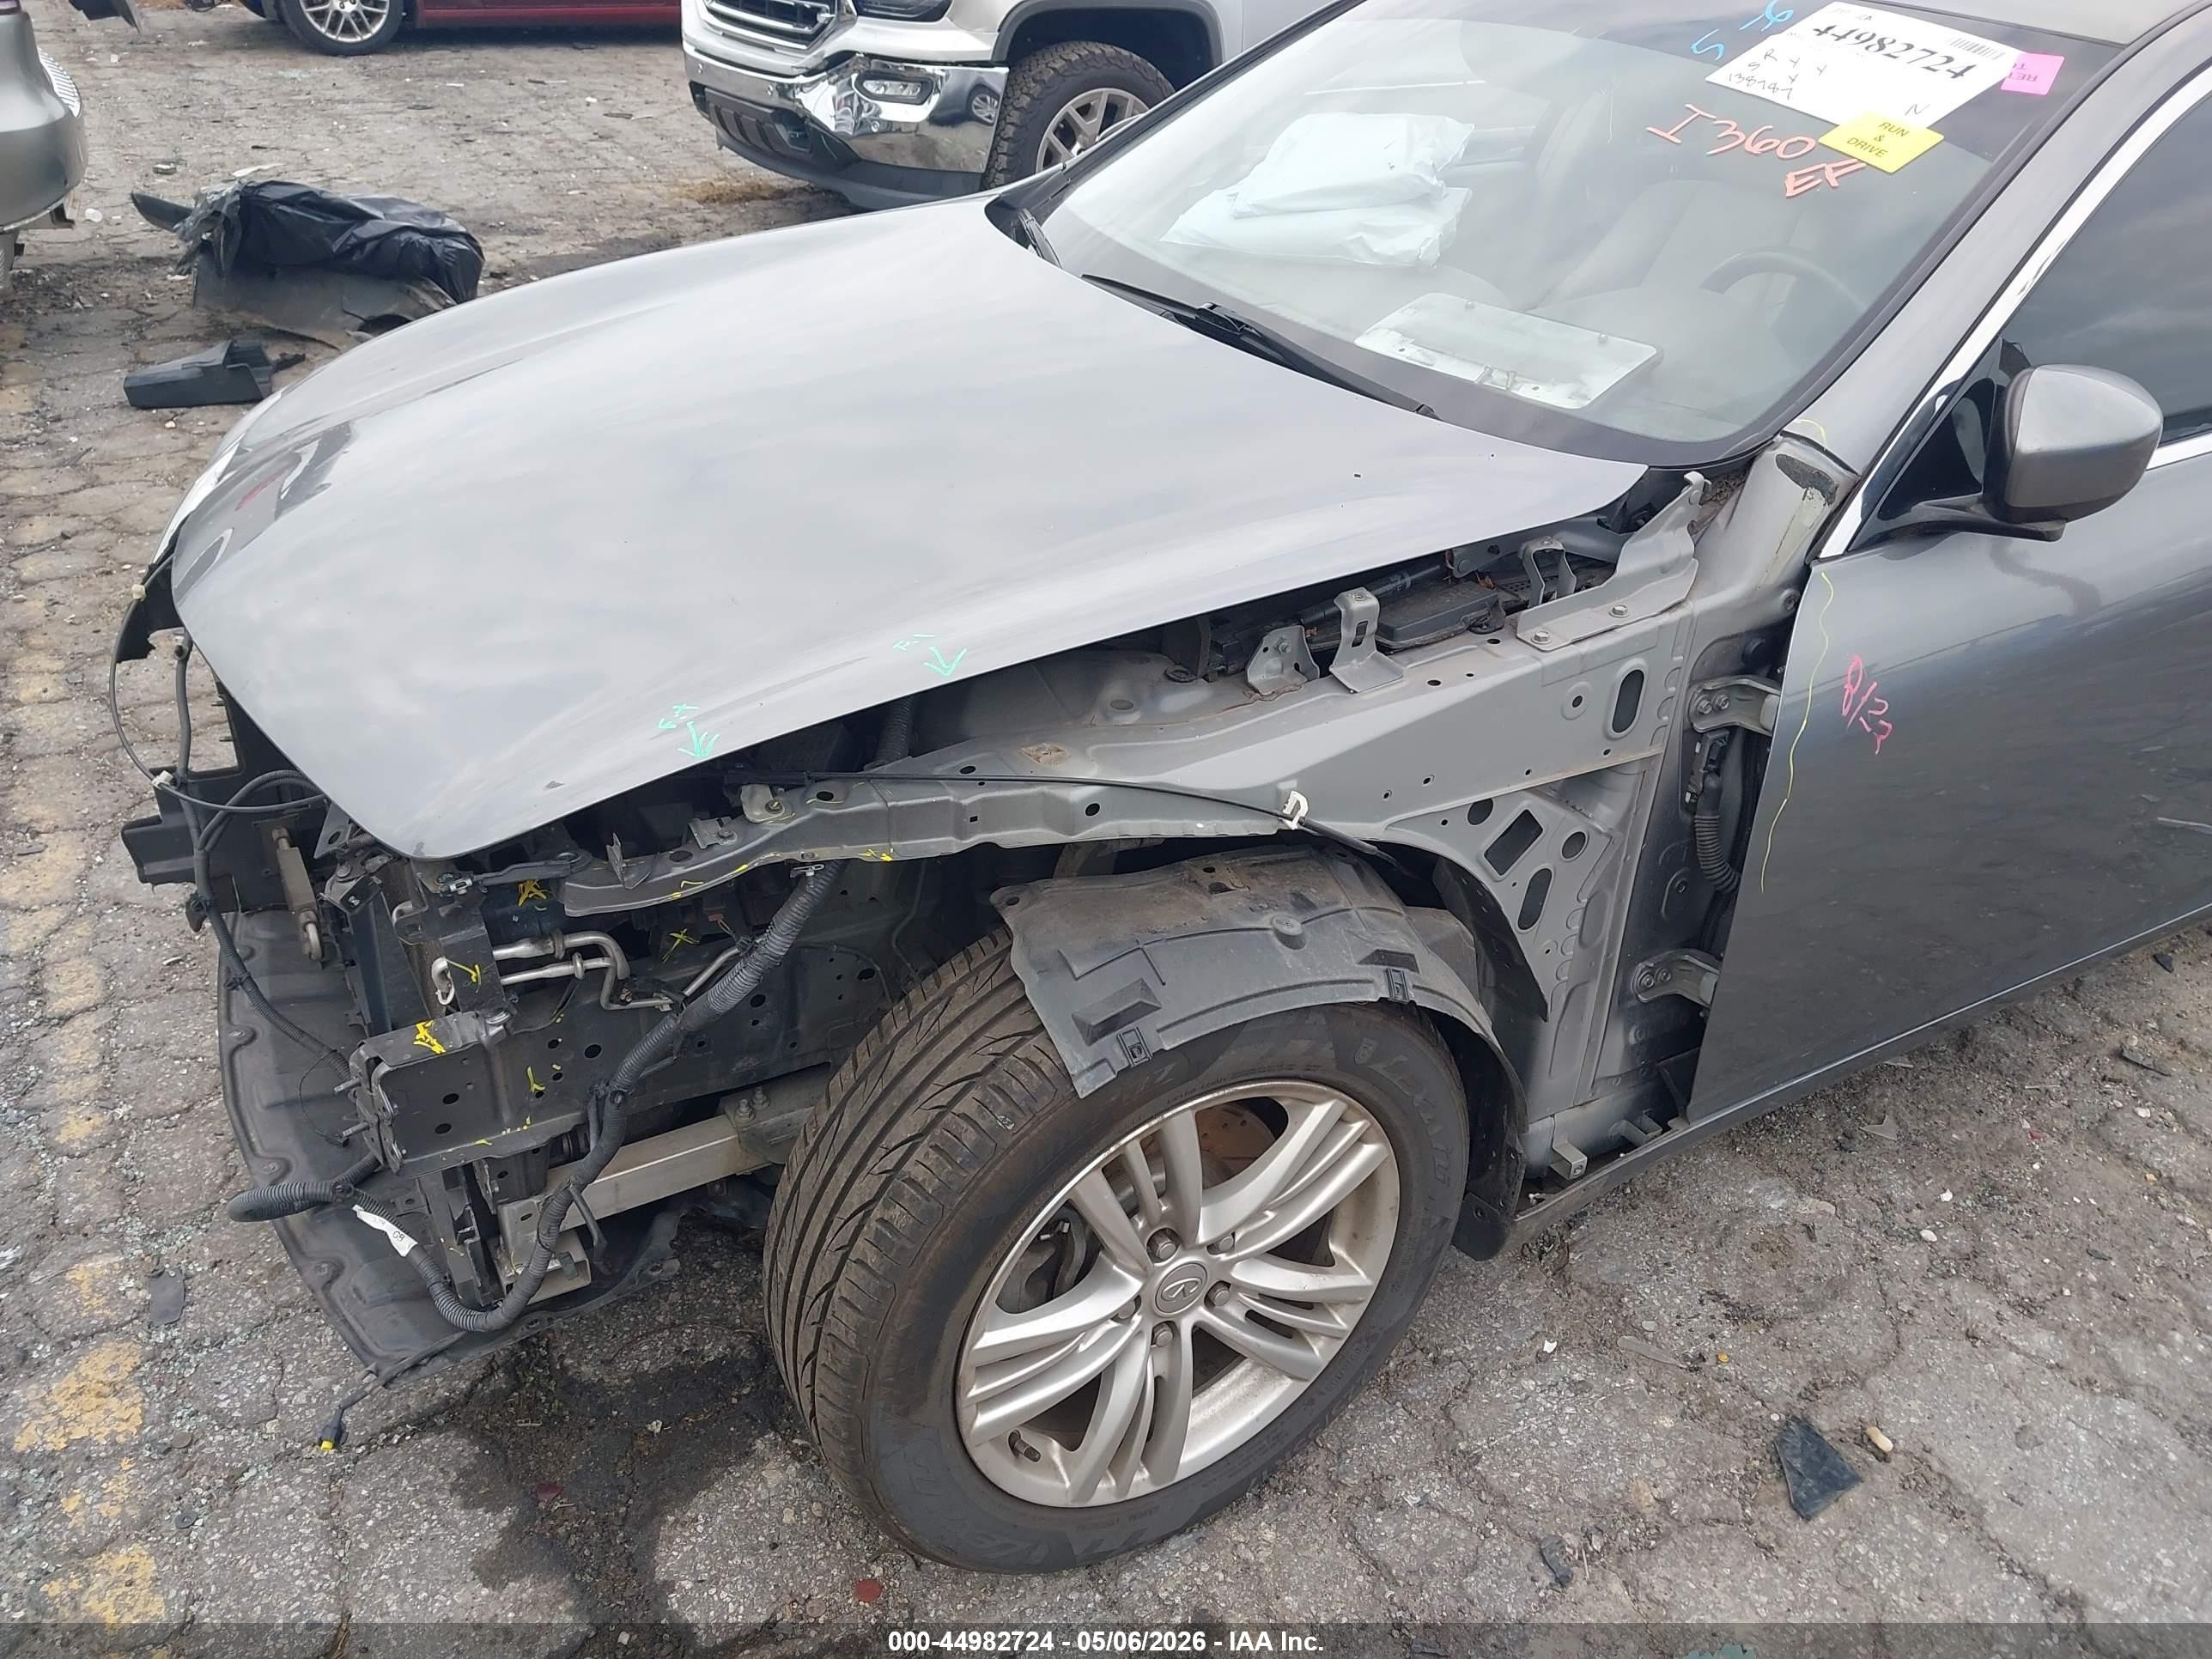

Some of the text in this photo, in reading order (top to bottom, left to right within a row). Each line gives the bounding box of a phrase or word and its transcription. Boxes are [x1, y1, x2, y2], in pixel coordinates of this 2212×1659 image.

[1813, 25, 1978, 79] 44982724
[1878, 122, 1910, 137] RUN
[1846, 137, 1888, 157] DRIVE
